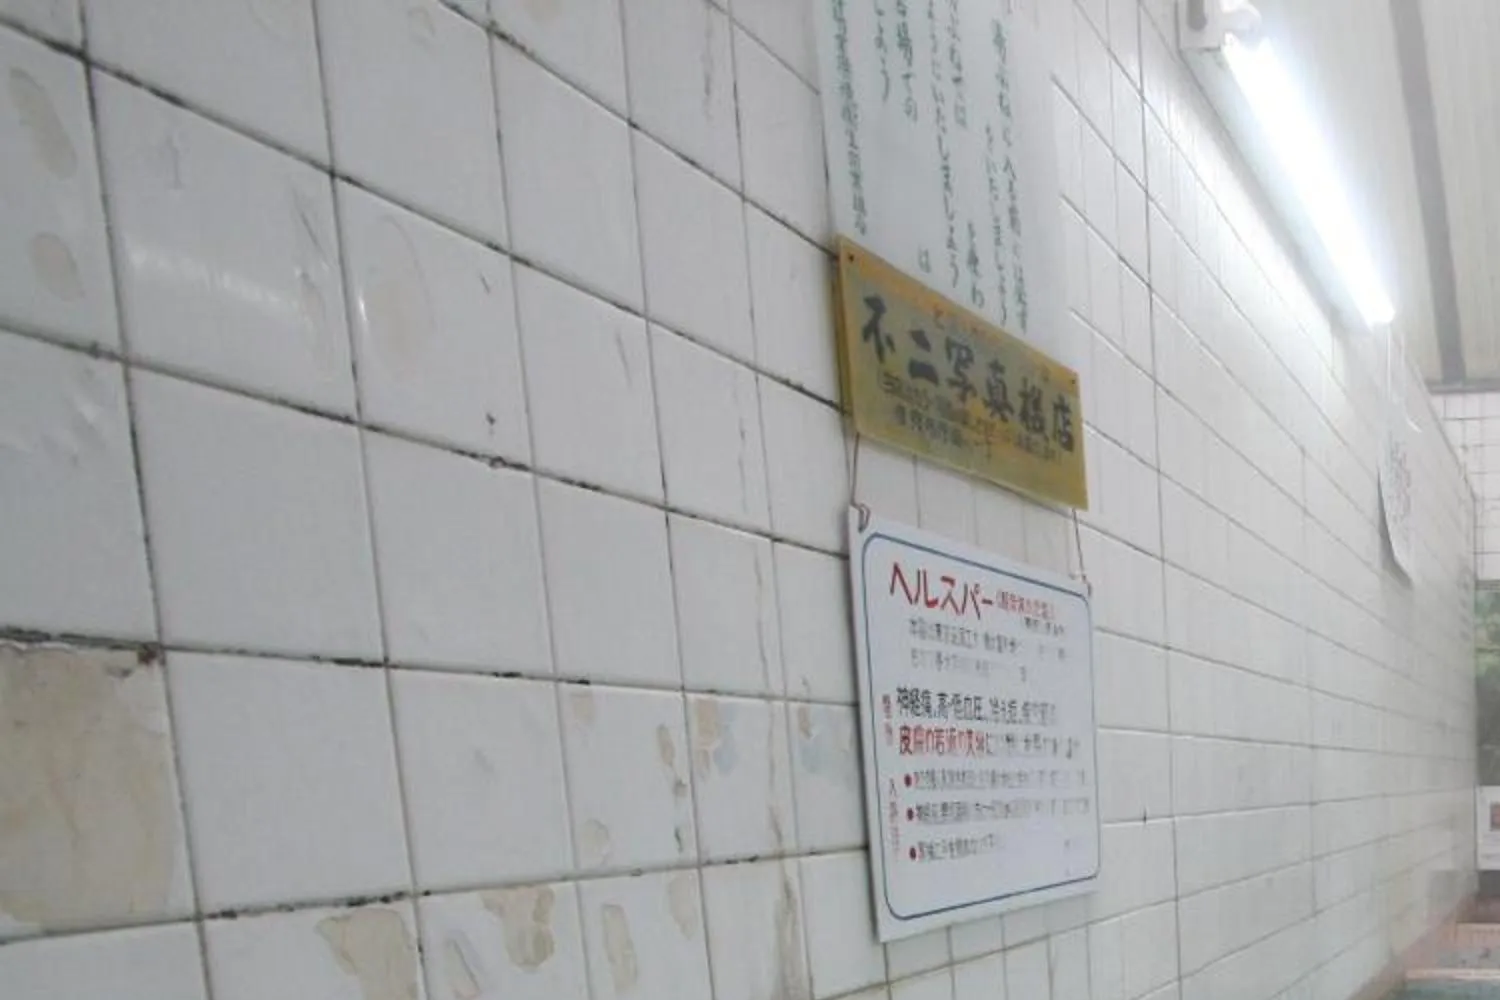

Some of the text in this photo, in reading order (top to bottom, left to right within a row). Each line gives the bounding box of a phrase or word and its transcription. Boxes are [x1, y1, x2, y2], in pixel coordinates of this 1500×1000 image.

[889, 561, 995, 621] ヘルスバー
